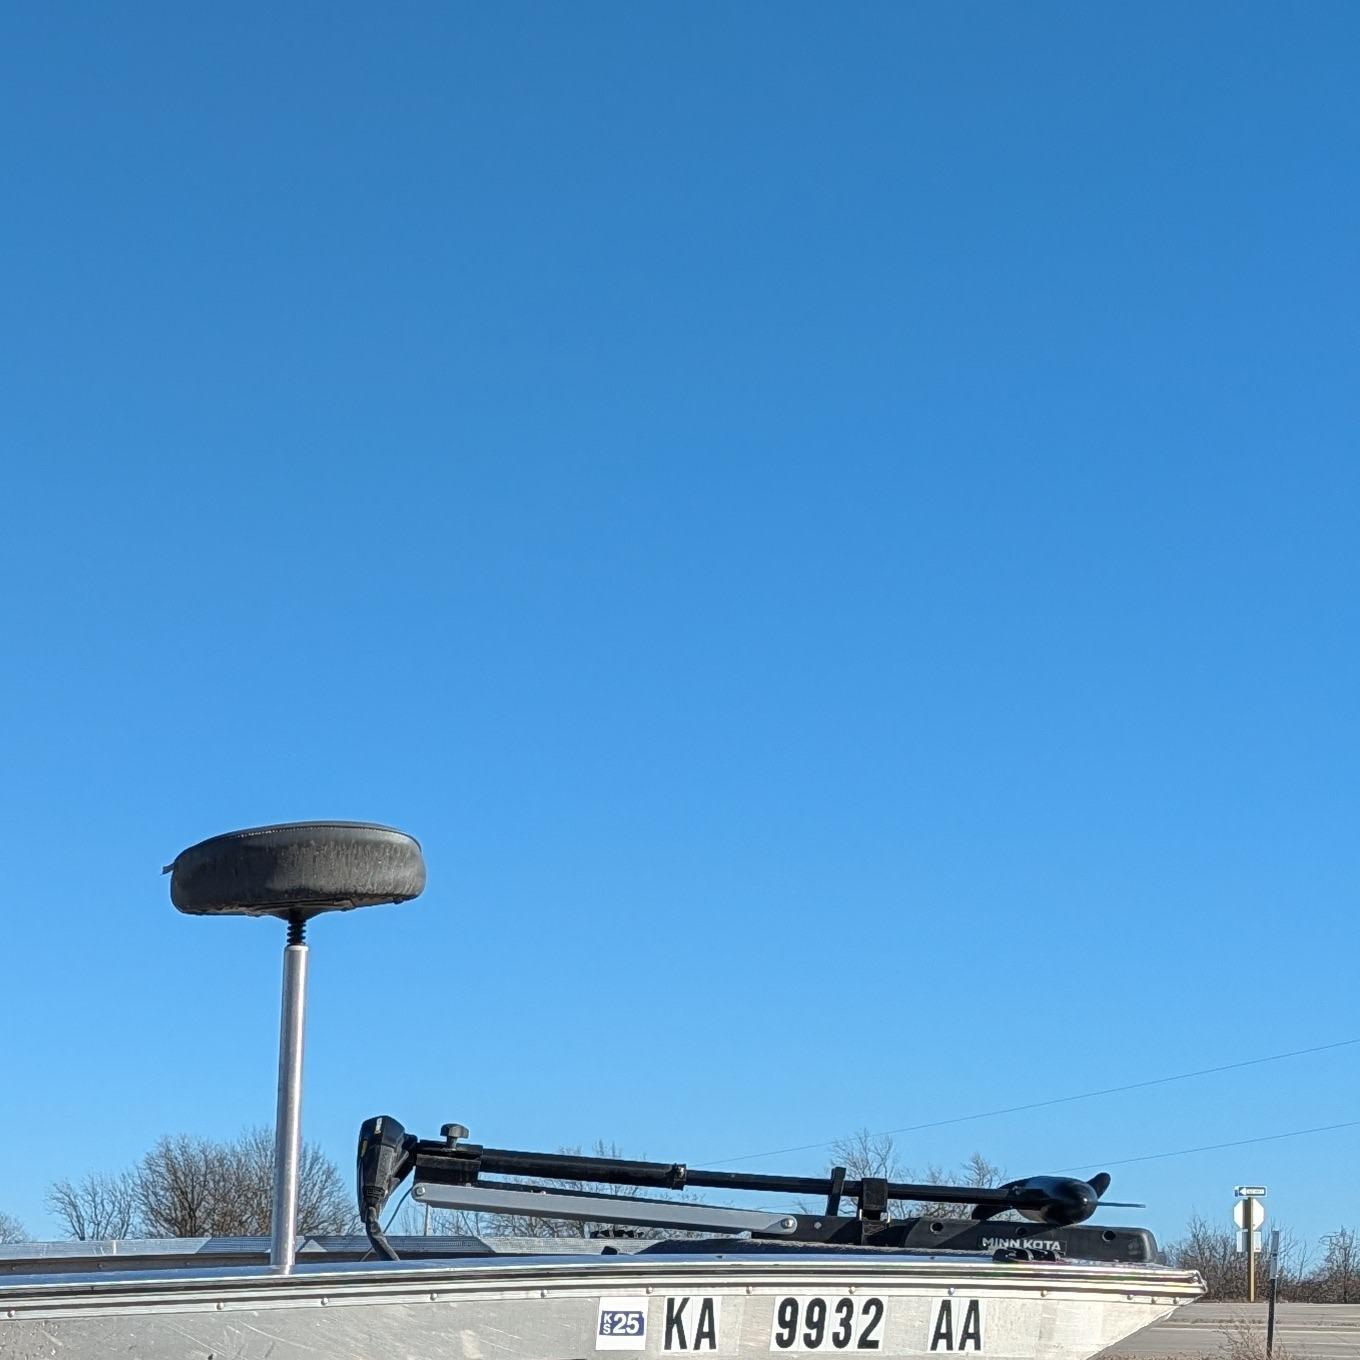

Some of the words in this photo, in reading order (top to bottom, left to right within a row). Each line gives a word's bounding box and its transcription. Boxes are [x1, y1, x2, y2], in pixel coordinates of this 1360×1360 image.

[982, 1237, 1020, 1250] MINN
[1023, 1239, 1061, 1251] KOTA
[613, 1313, 640, 1334] 25
[664, 1297, 716, 1350] KA
[775, 1297, 884, 1349] 9932
[930, 1299, 982, 1351] AA
